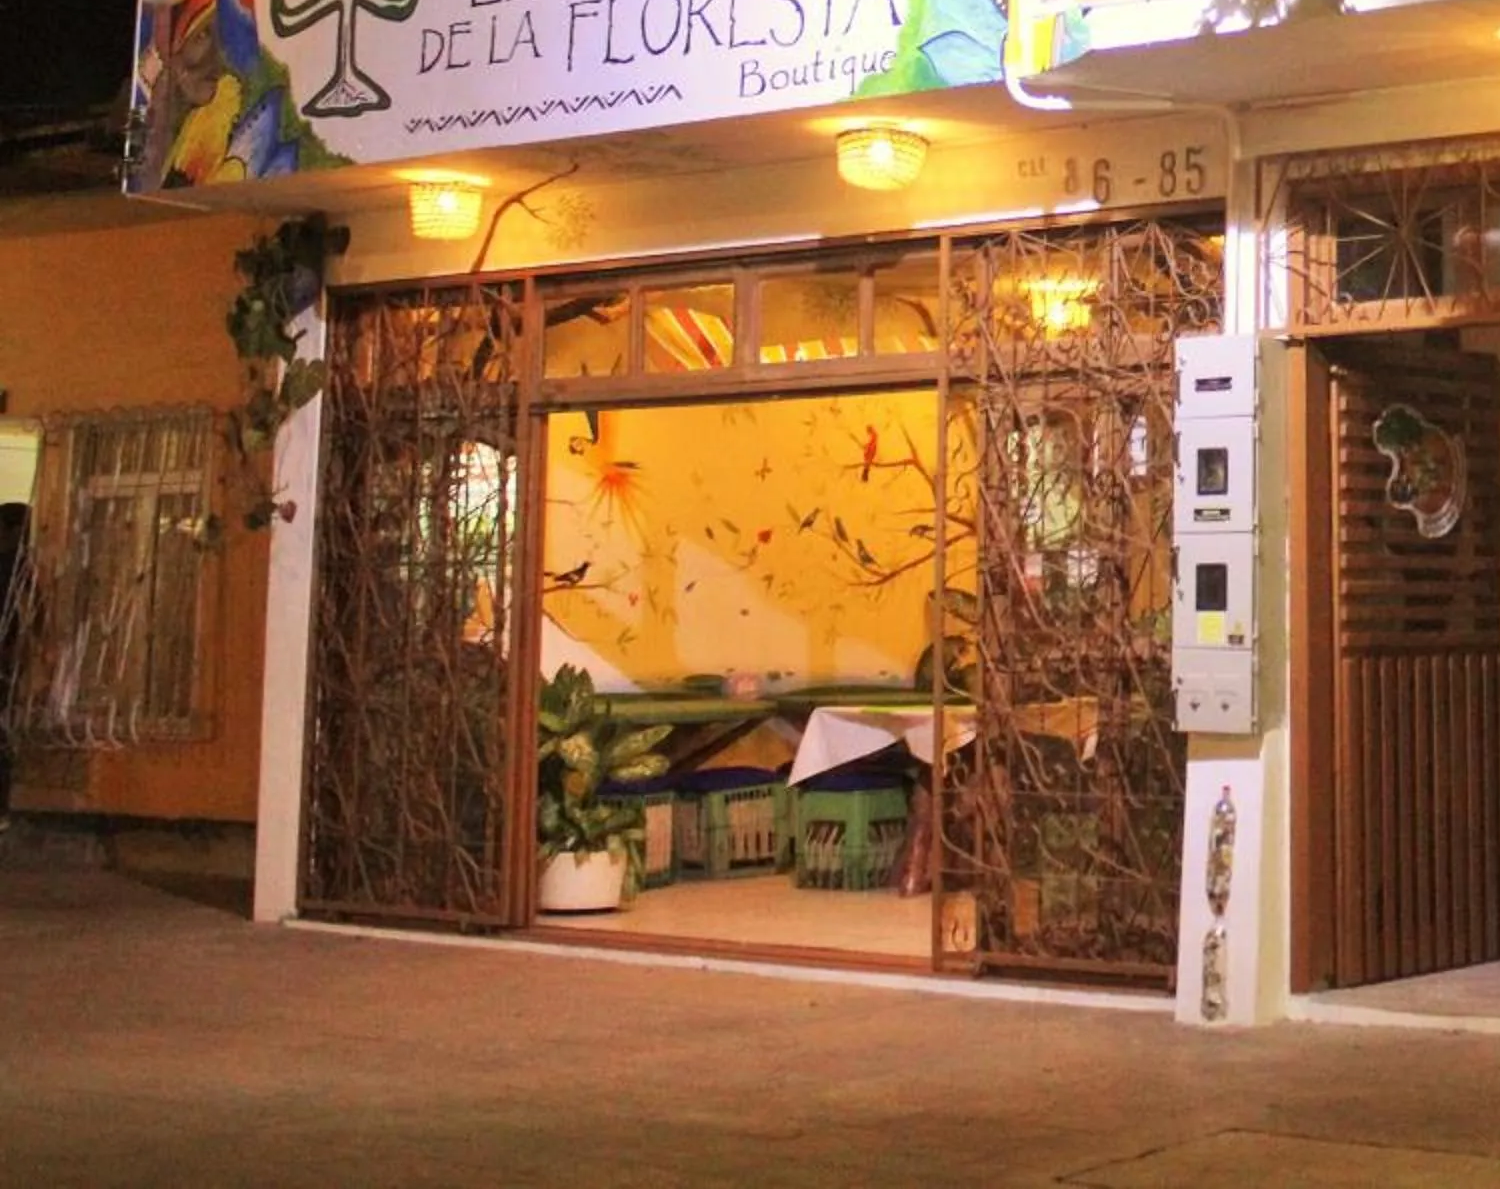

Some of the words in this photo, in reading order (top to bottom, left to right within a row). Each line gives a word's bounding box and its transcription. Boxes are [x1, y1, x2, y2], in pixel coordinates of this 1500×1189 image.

[418, 21, 472, 75] DE
[487, 10, 541, 66] LA
[738, 47, 897, 98] Boutique
